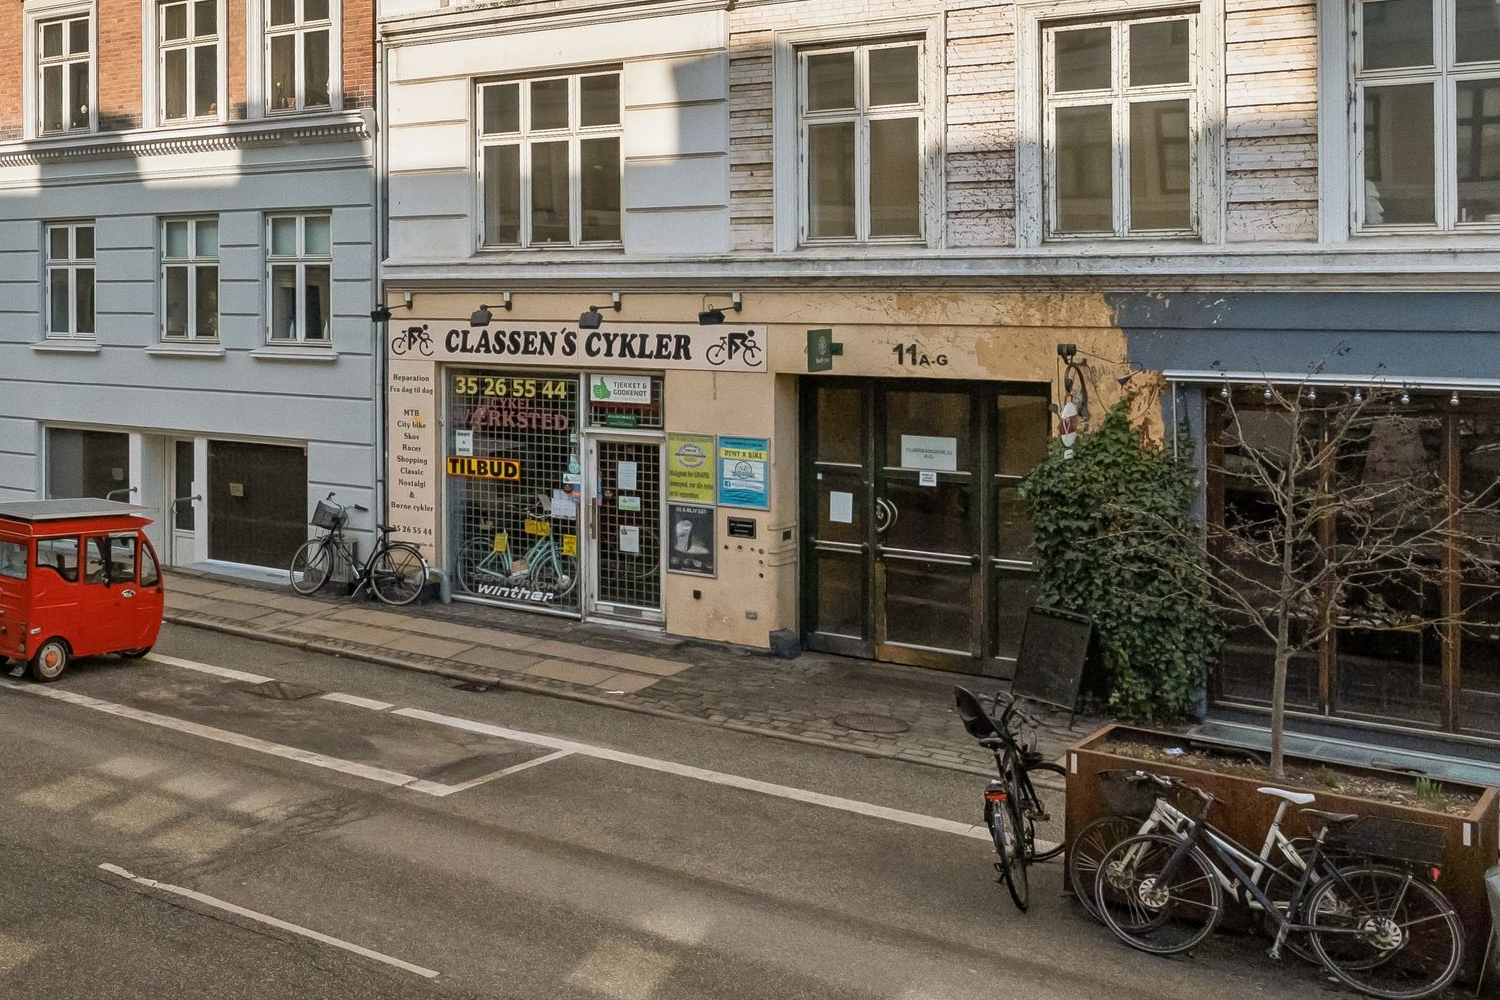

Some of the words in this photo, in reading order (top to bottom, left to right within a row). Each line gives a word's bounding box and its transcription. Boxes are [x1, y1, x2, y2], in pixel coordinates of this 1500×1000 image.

[585, 331, 692, 360] CYKLER
[393, 373, 430, 382] Reparation
[455, 376, 478, 394] 35
[484, 377, 507, 396] 26
[512, 378, 537, 398] 55
[542, 380, 567, 399] 44
[613, 381, 640, 389] TJEKKET
[401, 386, 413, 394] dag
[422, 387, 433, 395] dag
[613, 389, 647, 397] GODKENDT
[397, 420, 410, 429] City
[412, 421, 426, 429] bike
[402, 443, 421, 452] Racer
[396, 455, 428, 465] Shopping
[400, 467, 424, 475] Classic
[449, 458, 518, 478] TILBUD
[398, 479, 426, 488] Nostalgi
[409, 491, 415, 499] &
[412, 504, 434, 512] cykler
[402, 525, 411, 533] 26
[412, 526, 421, 534] 55
[477, 584, 554, 602] winther
